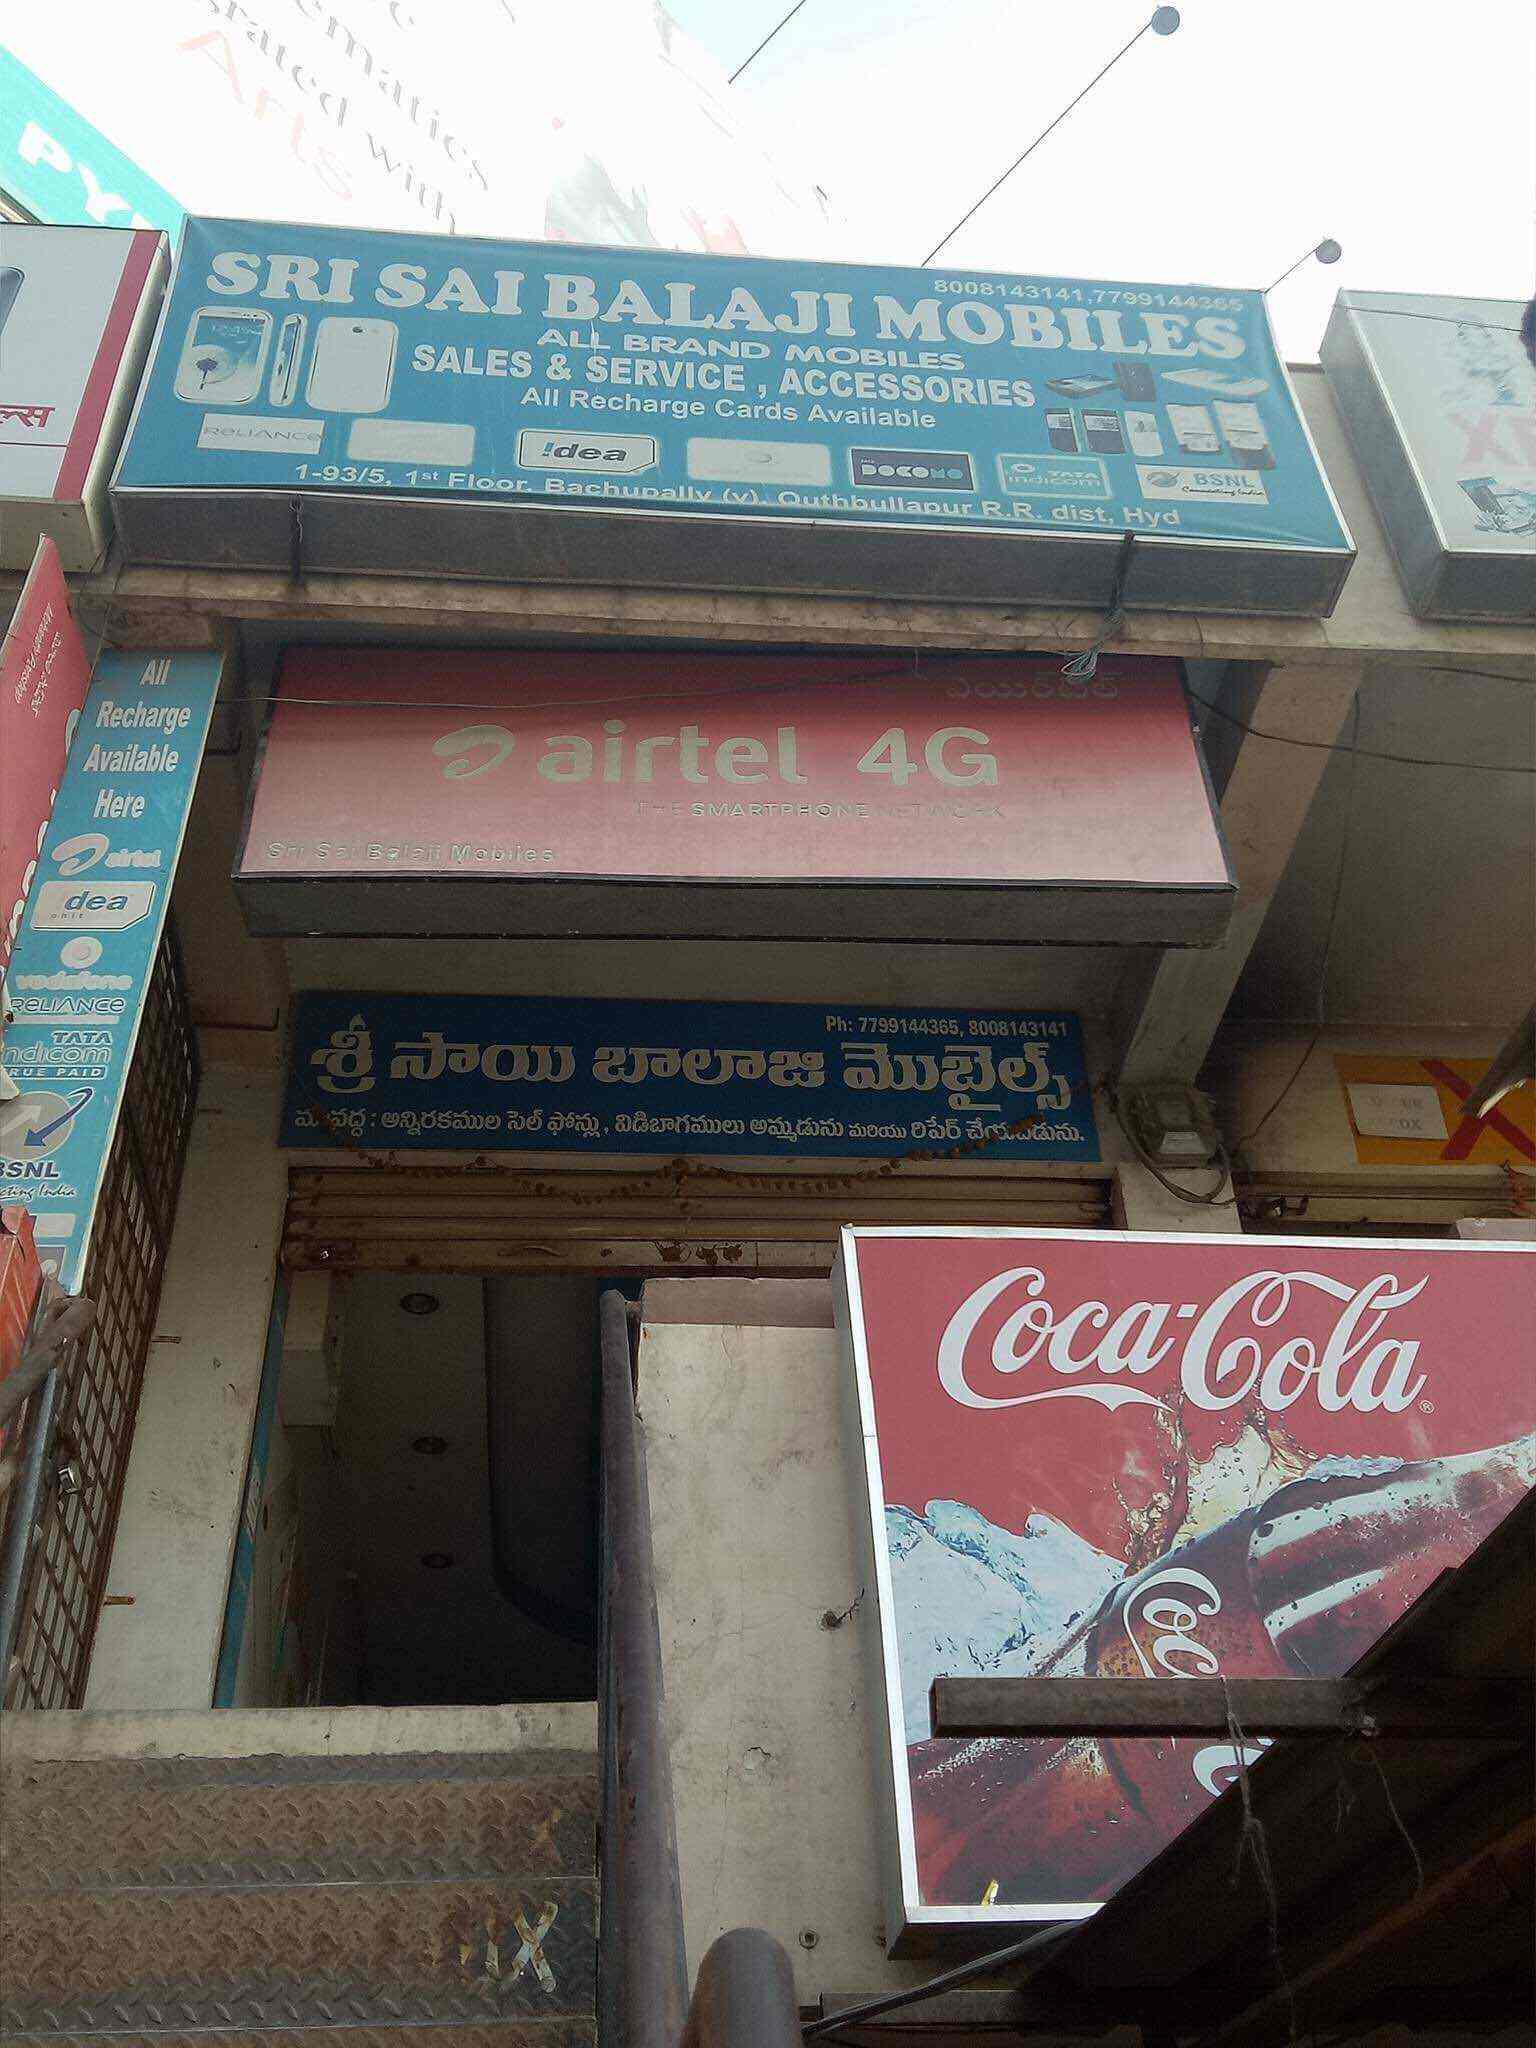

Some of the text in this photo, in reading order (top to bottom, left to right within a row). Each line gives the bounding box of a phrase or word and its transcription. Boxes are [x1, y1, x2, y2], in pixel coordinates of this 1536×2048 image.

[206, 251, 1246, 359] SRI SAI BALAJI MOBILES
[537, 328, 966, 371] ALL BRAND MOBILES
[411, 344, 533, 378] SALES
[546, 354, 572, 381] &
[584, 356, 746, 392] SERVICE
[779, 367, 1037, 407] ACCESSORIES
[520, 388, 937, 429] All Recharge Cards Available
[1124, 509, 1182, 527] Hyd
[139, 657, 171, 685] All
[95, 701, 191, 734] Recharge
[83, 744, 179, 773] Available
[537, 719, 999, 787] airtel 4G
[93, 788, 146, 818] Here
[52, 1031, 113, 1044] TATA
[969, 1020, 1068, 1037] 8008143141
[8, 1066, 103, 1077] RUE PAID
[937, 1266, 1430, 1412] Coca-Cola
